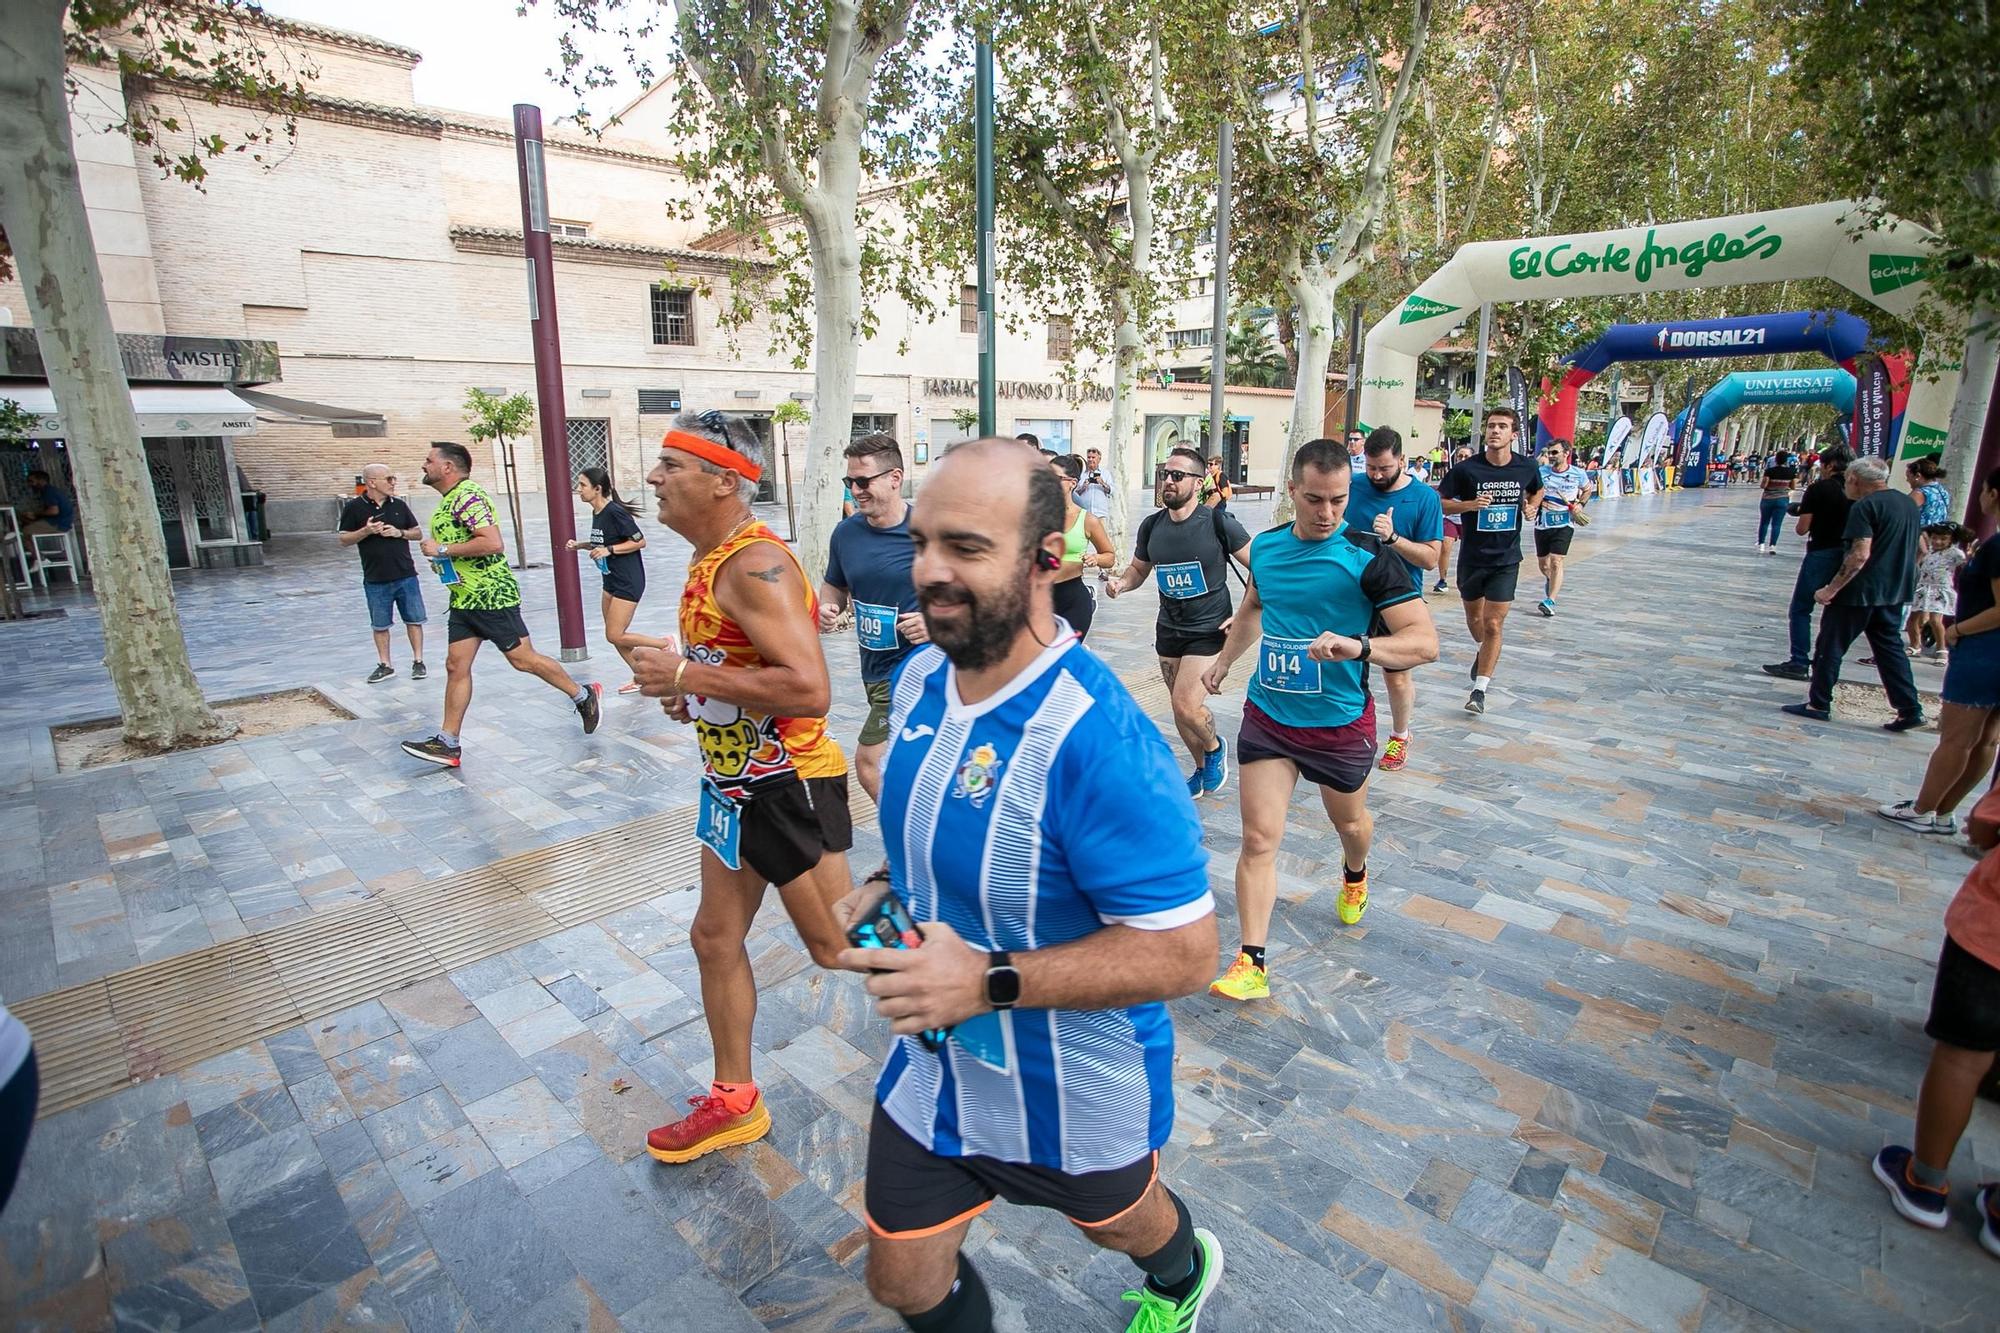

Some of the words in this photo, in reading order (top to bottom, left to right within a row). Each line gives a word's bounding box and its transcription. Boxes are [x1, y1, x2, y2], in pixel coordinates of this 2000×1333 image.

[1509, 244, 1541, 279] El
[1545, 244, 1630, 277] Corte
[1635, 225, 1782, 282] Inglés
[1883, 266, 1909, 277] Corte
[1670, 328, 1766, 347] DORSAL21
[167, 351, 244, 367] AMSTEL
[923, 378, 978, 398] FARMAC
[998, 381, 1053, 400] ALFONSO
[1055, 384, 1063, 400] X
[1744, 377, 1834, 390] UNIVERSAE
[1477, 482, 1481, 490] I
[1482, 481, 1520, 490] CARRERA
[1488, 511, 1508, 523] 038
[1166, 573, 1193, 588] 044
[860, 615, 882, 636] 209
[1268, 652, 1302, 675] 014
[710, 803, 730, 839] 141
